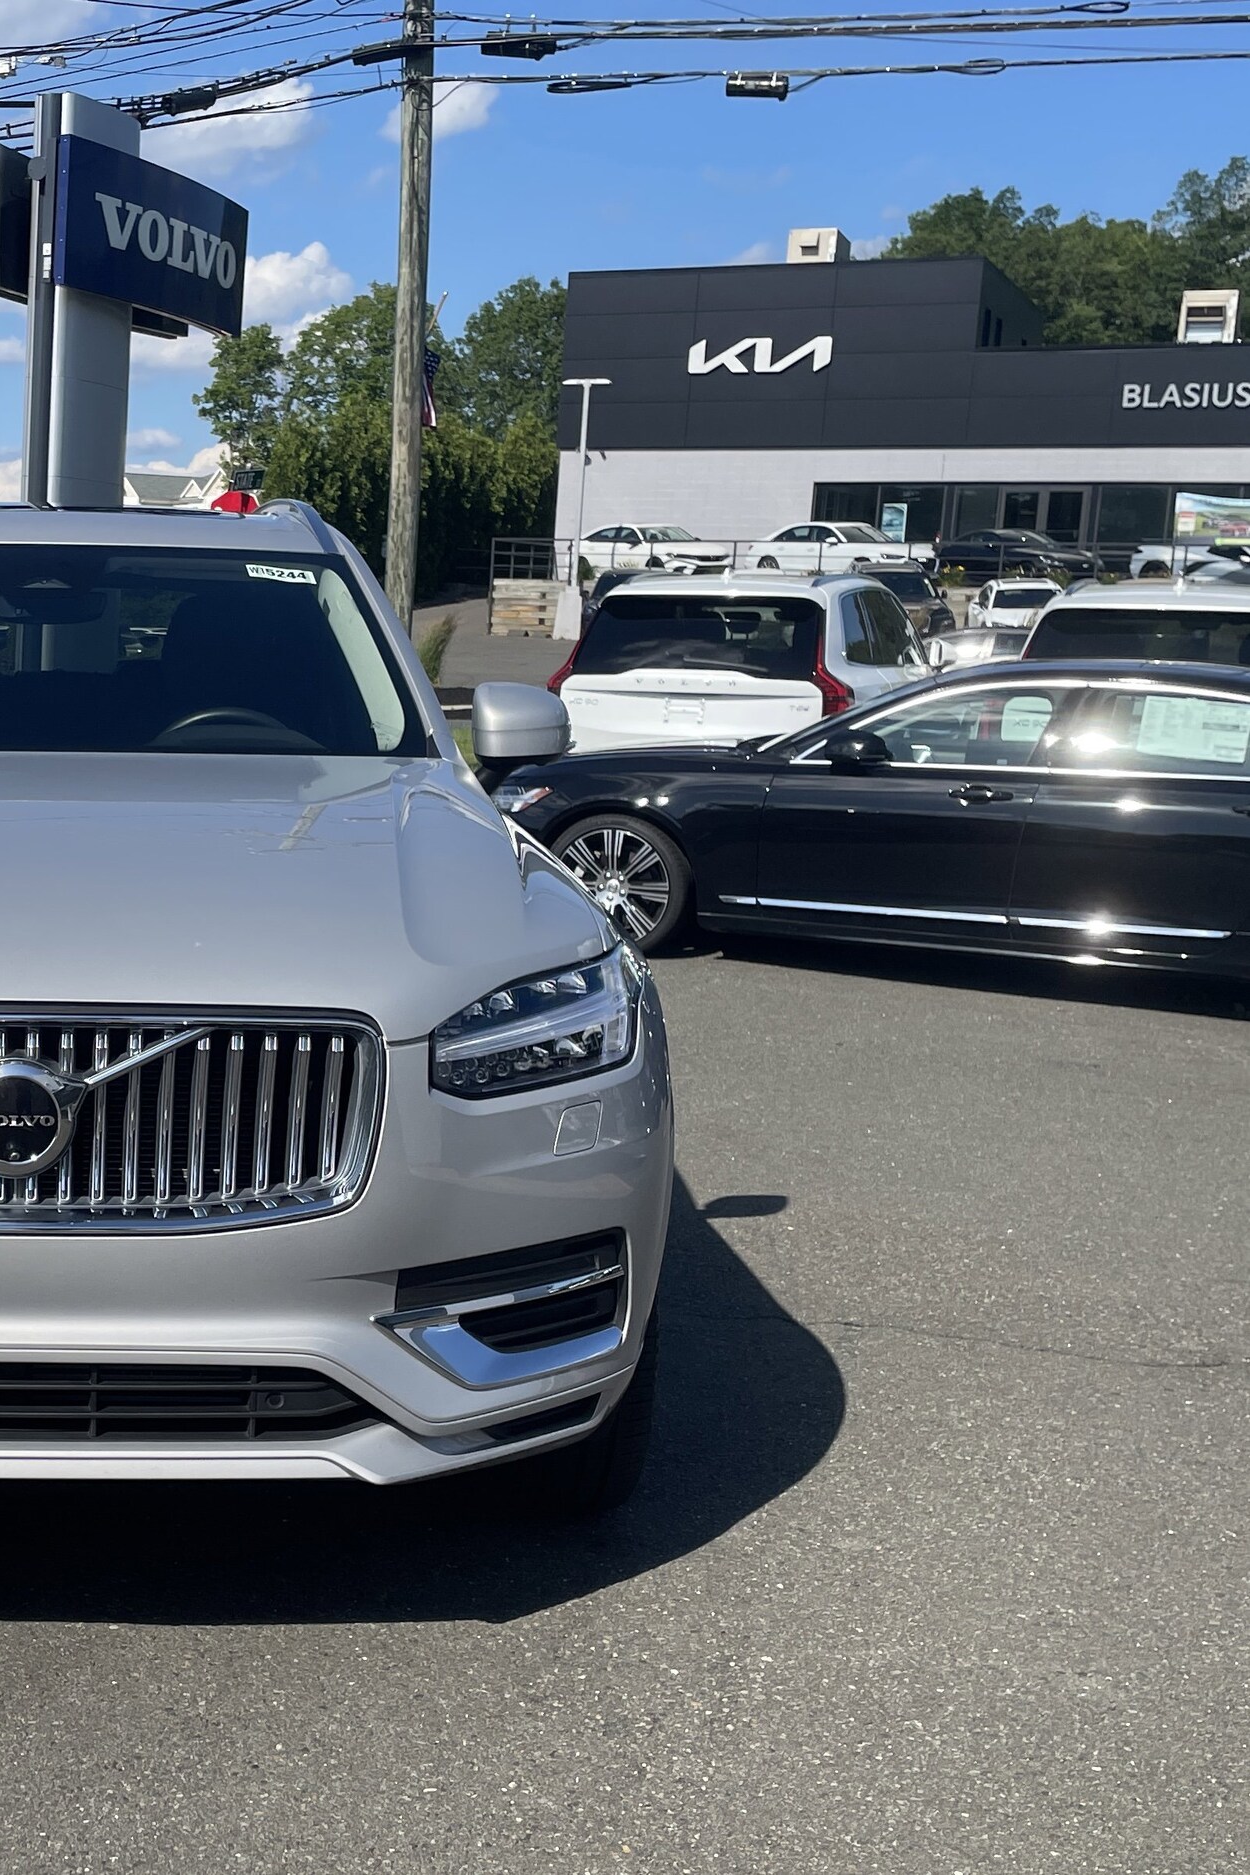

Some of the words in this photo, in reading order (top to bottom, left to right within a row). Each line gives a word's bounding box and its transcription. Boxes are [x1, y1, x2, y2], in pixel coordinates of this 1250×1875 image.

[95, 192, 236, 289] VOLVO
[688, 336, 833, 374] KIA
[1121, 382, 1250, 408] BLASIUS
